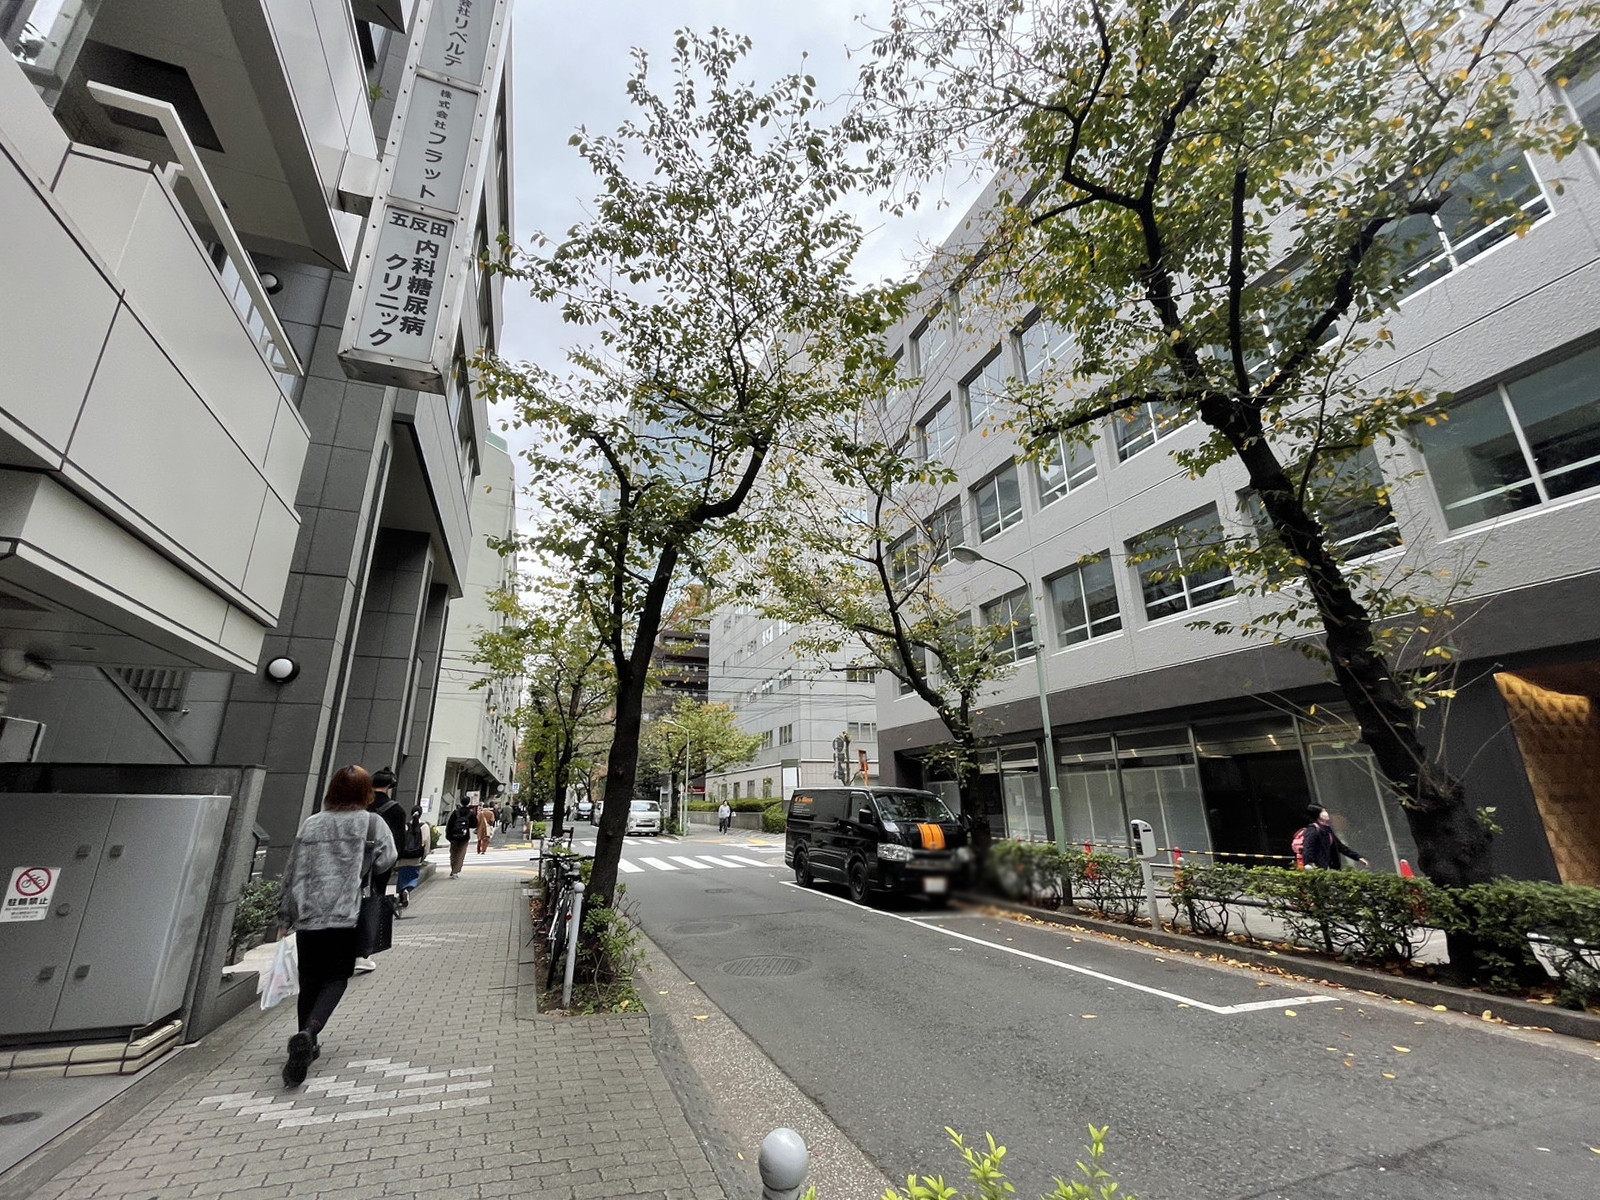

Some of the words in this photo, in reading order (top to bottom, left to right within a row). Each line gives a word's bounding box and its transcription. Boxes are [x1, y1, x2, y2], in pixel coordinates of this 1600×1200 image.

[389, 210, 448, 239] 五反田
[369, 253, 408, 347] クリニック
[399, 239, 440, 336] 内科糖尿病
